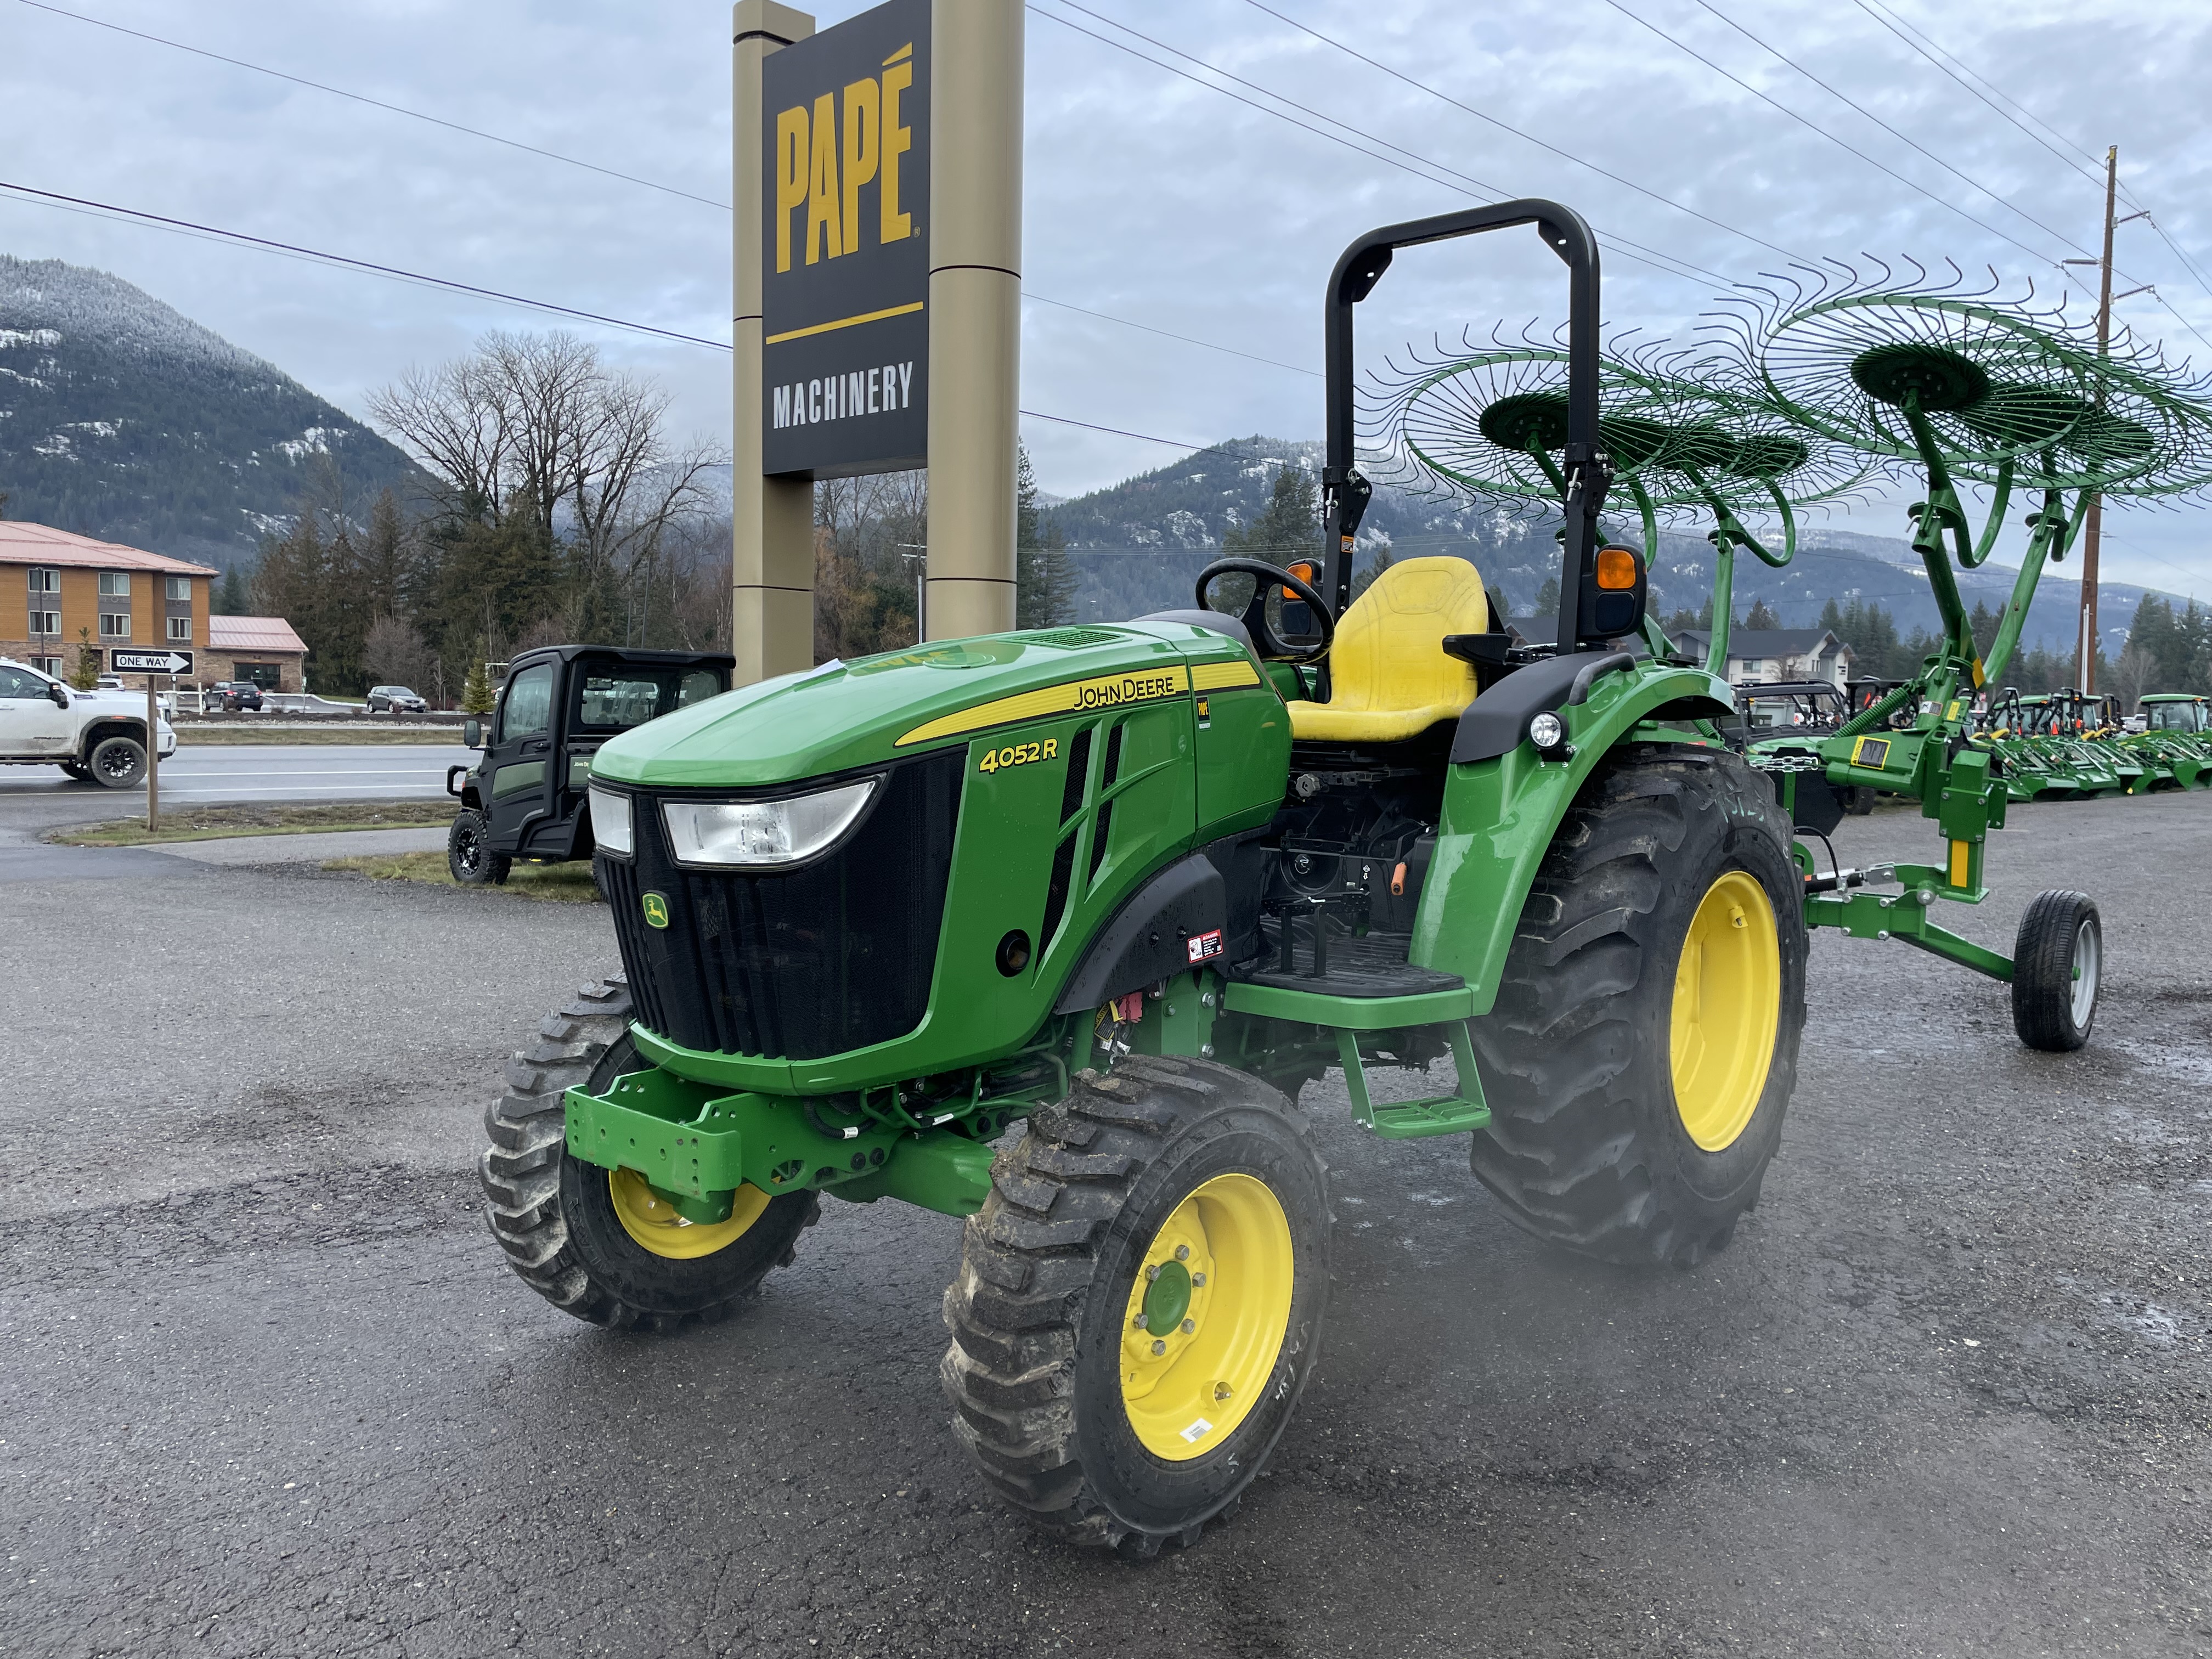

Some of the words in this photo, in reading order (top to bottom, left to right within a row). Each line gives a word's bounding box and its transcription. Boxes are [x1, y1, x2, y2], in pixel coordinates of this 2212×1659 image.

[777, 42, 912, 273] PAPÉ
[774, 362, 913, 429] MACHINERY
[120, 657, 141, 665] ONE
[146, 658, 168, 667] WAY
[1074, 685, 1120, 707] JOHN
[1123, 677, 1174, 699] DEERE
